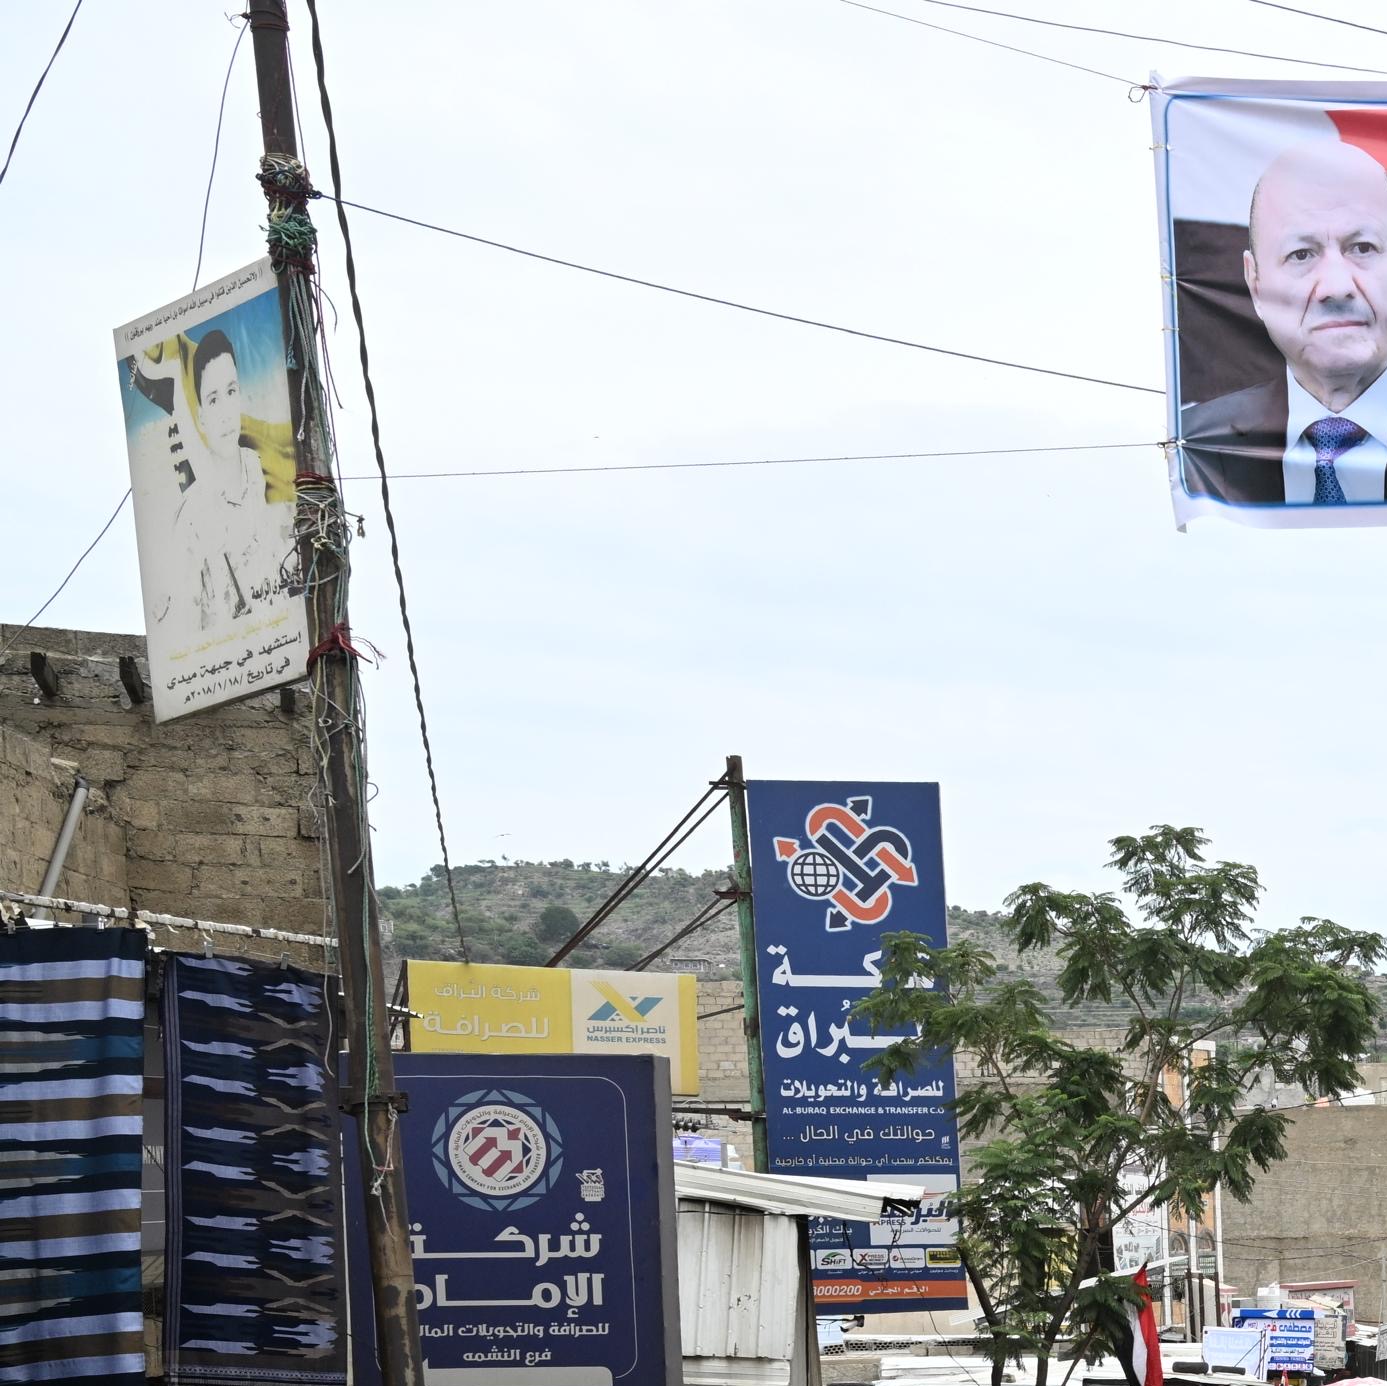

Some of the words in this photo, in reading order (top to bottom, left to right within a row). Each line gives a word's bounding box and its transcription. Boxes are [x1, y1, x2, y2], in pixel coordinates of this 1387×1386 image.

[236, 649, 253, 668] في
[276, 656, 291, 675] في
[199, 660, 233, 678] جبهة
[247, 662, 273, 684] تاريخ
[166, 672, 198, 690] ميدي
[491, 985, 540, 1003] شركة
[422, 1010, 550, 1042] للصرافة
[586, 1025, 638, 1036] اكسبرس
[641, 1025, 666, 1036] ناصر
[586, 1035, 622, 1044] NASSER
[625, 1036, 667, 1044] EXPRESS
[780, 1078, 867, 1102] والتحويلات
[871, 1078, 944, 1101] للصرافة
[783, 1107, 827, 1115] AL-BURAQ
[830, 1107, 876, 1115] EXCHANGE
[878, 1107, 884, 1115] &
[885, 1107, 928, 1115] TRANSFER
[800, 1125, 838, 1142] الحال
[844, 1126, 874, 1144] في
[879, 1125, 935, 1143] حوالتك
[775, 1157, 805, 1167] خارجية
[807, 1154, 816, 1166] أو
[818, 1156, 846, 1166] محلية
[848, 1156, 873, 1166] حوالة
[876, 1154, 889, 1166] أي
[891, 1156, 915, 1166] سحب
[917, 1156, 953, 1166] يمكنكم
[832, 1225, 853, 1234] بنك
[868, 1286, 900, 1297] المجاني
[902, 1285, 929, 1295] الرقم
[418, 1324, 455, 1338] المال
[457, 1322, 545, 1341] والتحويلات
[549, 1322, 610, 1339] للصرافة
[462, 1345, 521, 1362] النشمه
[524, 1348, 552, 1366] فرع
